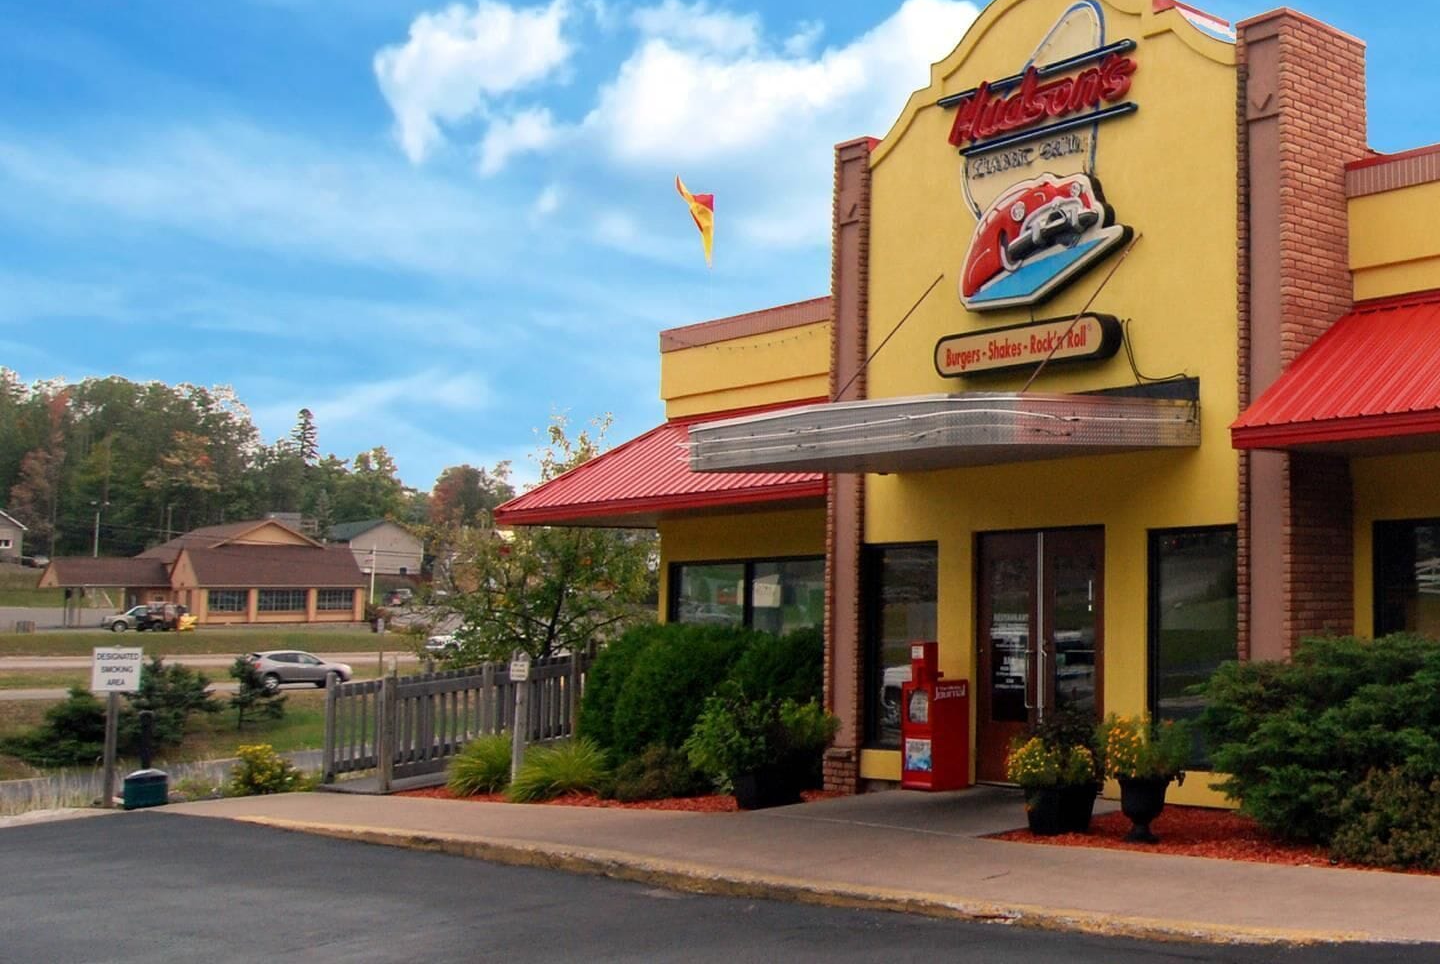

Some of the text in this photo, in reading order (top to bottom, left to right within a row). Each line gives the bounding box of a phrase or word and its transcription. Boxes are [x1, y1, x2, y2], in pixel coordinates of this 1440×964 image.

[948, 52, 1137, 147] Hudson's
[946, 348, 980, 370] Burgers
[988, 338, 1022, 360] Shakes
[1067, 324, 1087, 348] Roll
[97, 652, 139, 660] DESIGNATED
[934, 684, 966, 701] Journal
